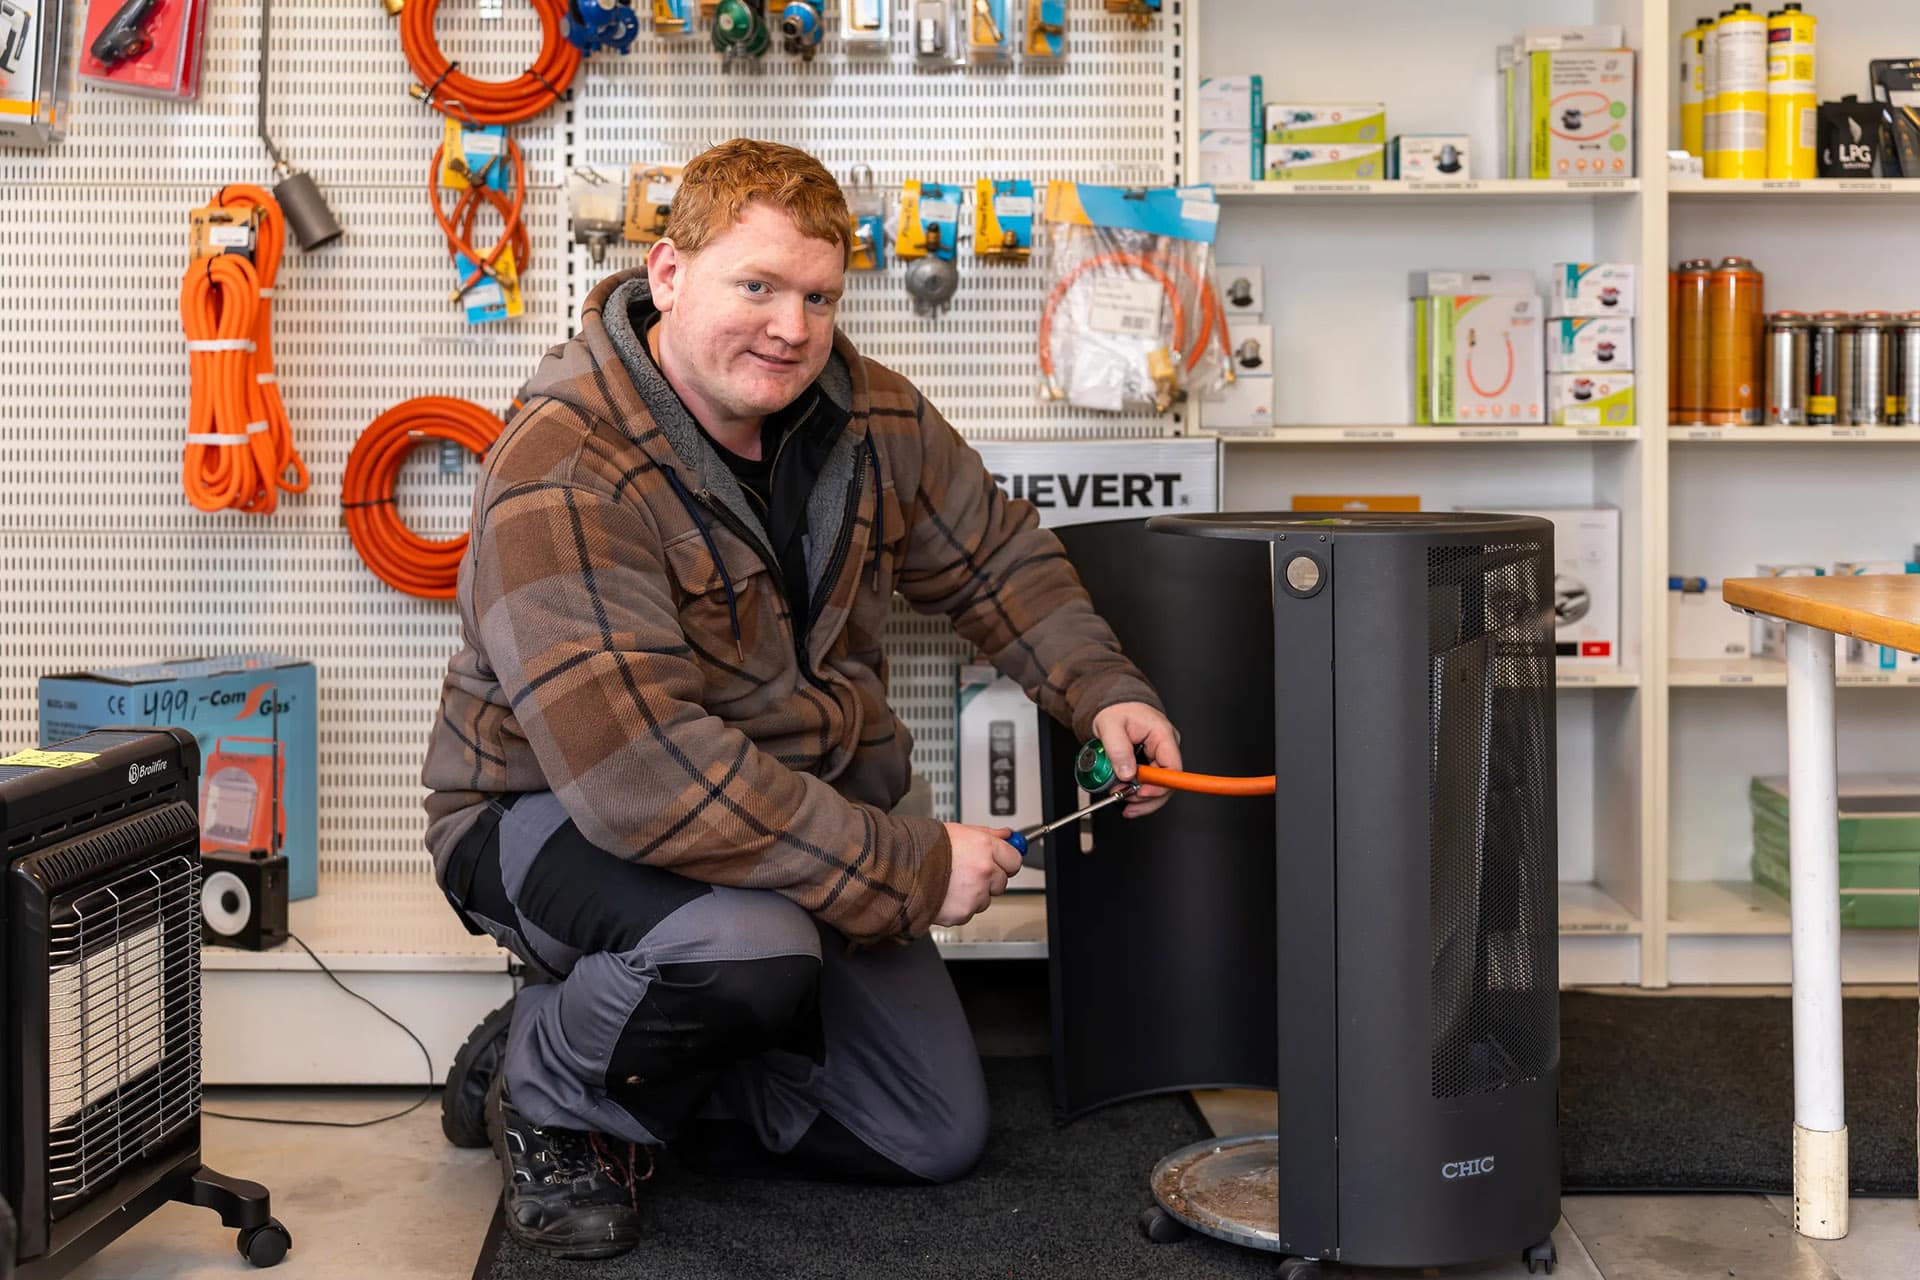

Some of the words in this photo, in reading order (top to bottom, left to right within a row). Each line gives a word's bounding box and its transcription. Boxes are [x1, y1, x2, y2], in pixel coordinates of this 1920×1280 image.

[1839, 144, 1872, 162] LPG
[210, 690, 246, 706] Com
[140, 759, 168, 778] Broilfire
[1441, 1155, 1495, 1178] CHIC
